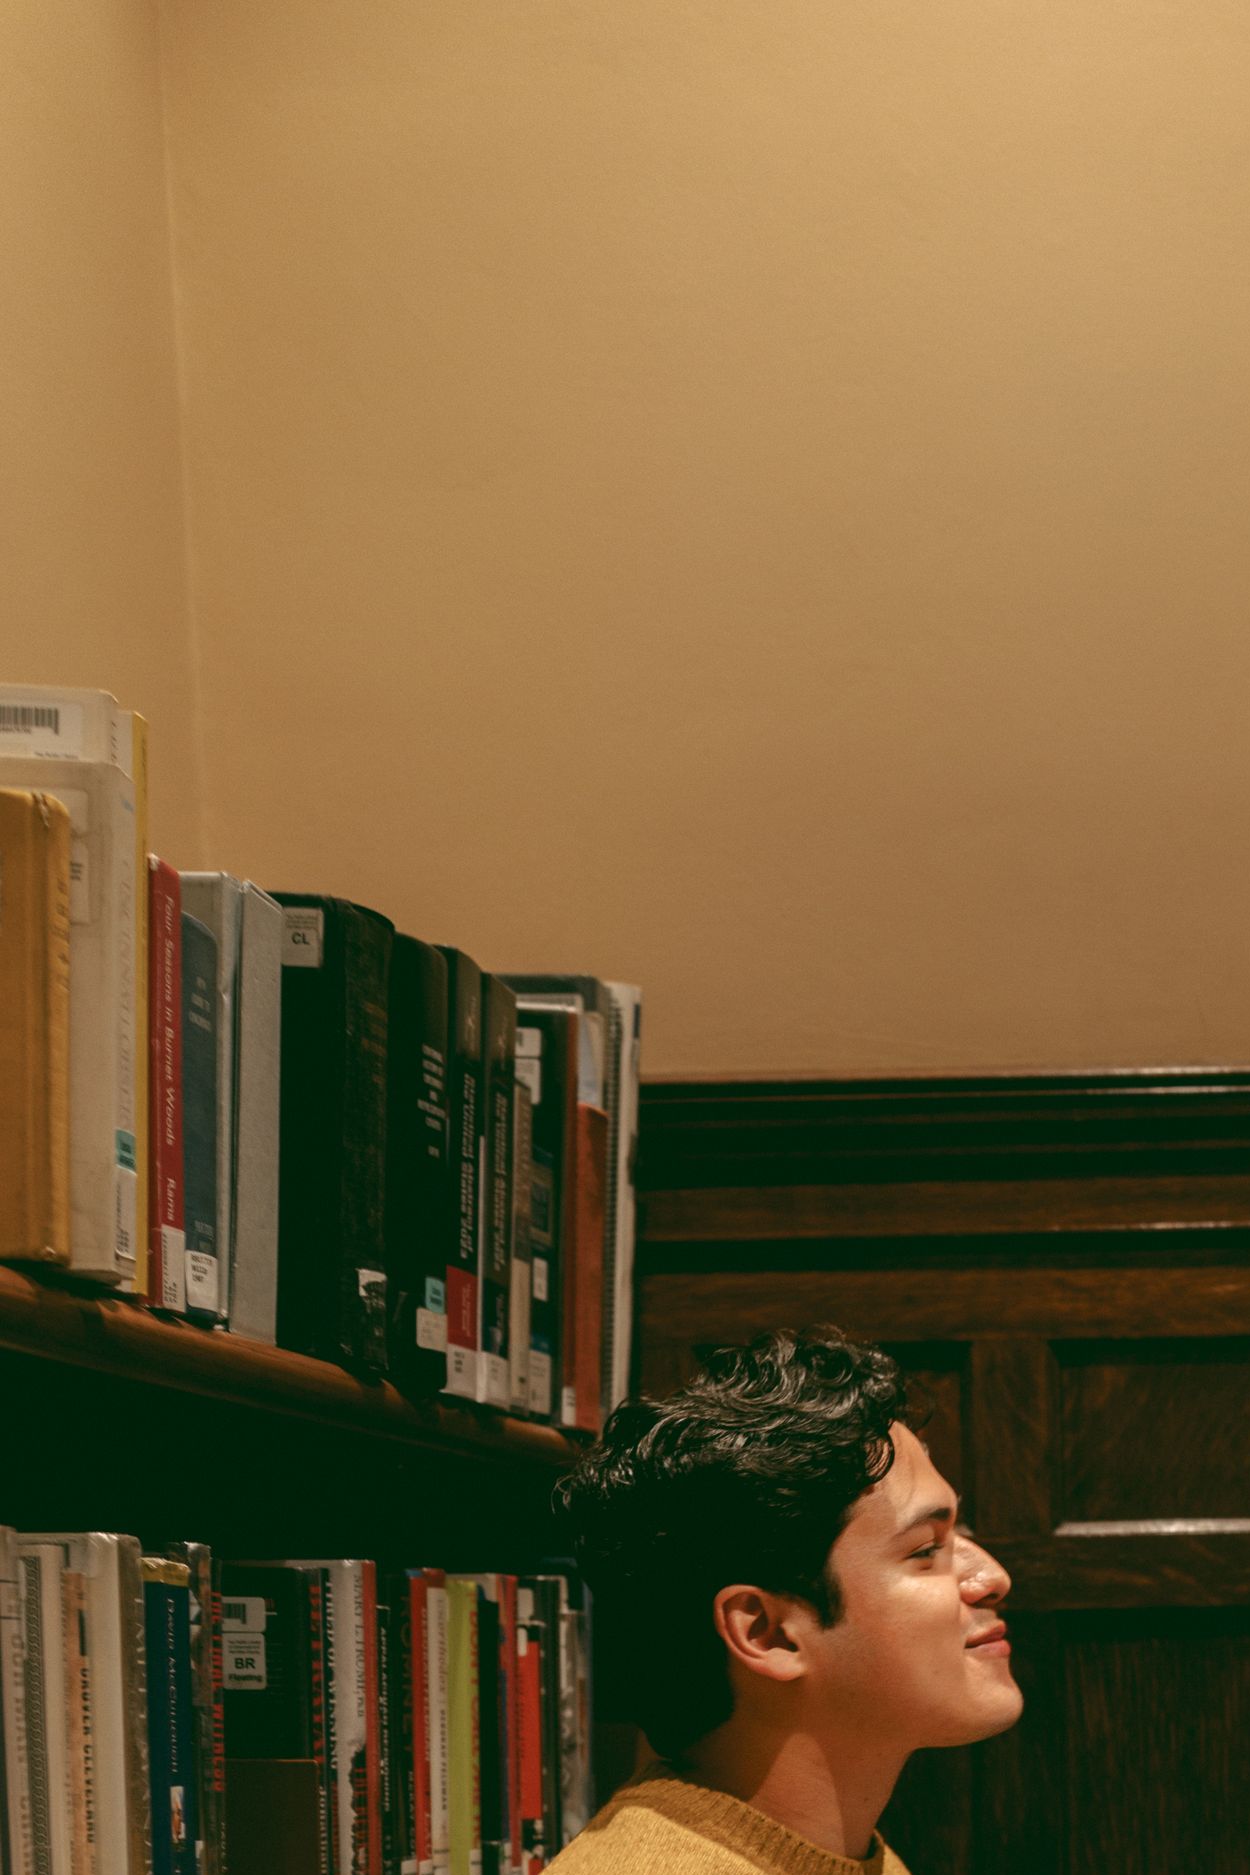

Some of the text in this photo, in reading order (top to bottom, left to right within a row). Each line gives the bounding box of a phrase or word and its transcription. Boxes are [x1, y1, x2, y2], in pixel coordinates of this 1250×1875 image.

[165, 894, 176, 933] Four
[291, 931, 311, 946] CL
[165, 938, 176, 1003] Seasons
[165, 1026, 176, 1083] Burnet
[166, 1087, 177, 1147] Woods
[354, 1575, 364, 1617] MARY
[211, 1634, 224, 1690] FINAL
[234, 1657, 257, 1670] BR
[80, 1667, 97, 1844] GROVER CLEVELAND
[213, 1702, 226, 1792] WITNESS
